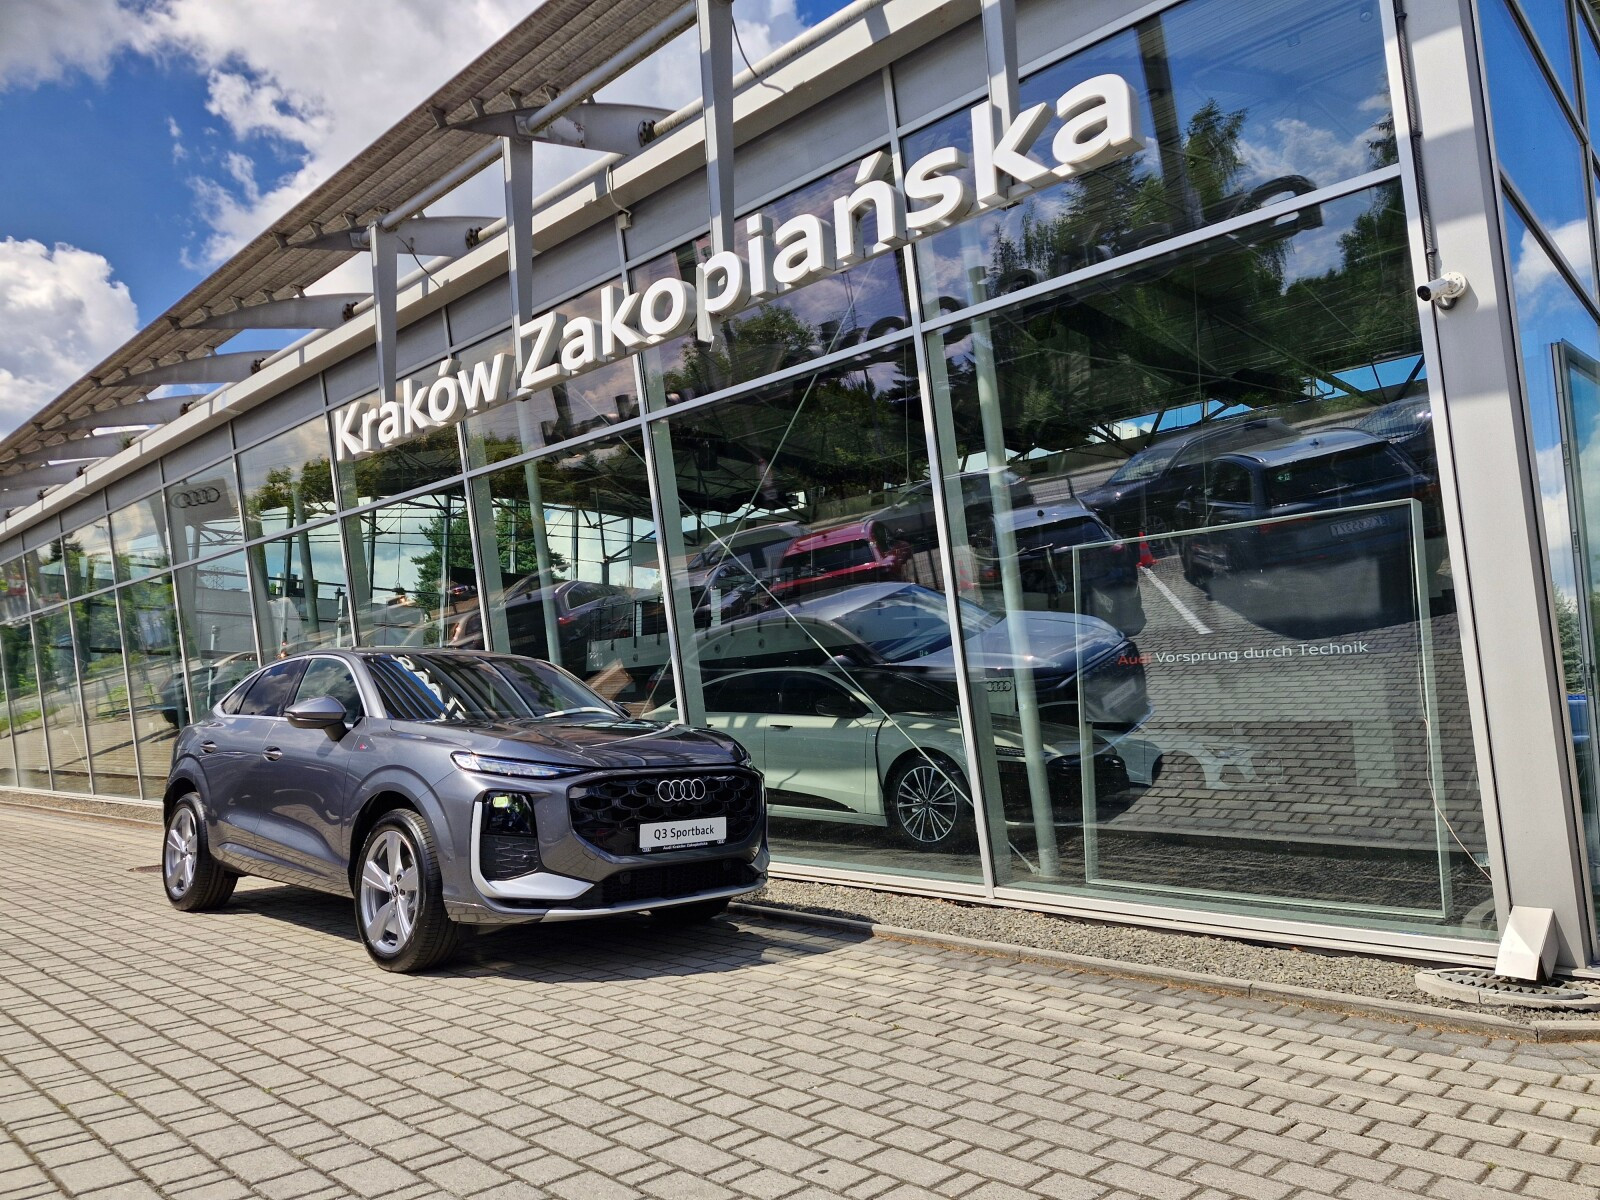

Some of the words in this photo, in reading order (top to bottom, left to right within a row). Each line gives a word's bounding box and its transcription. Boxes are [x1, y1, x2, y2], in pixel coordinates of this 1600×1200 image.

[334, 352, 516, 463] Kraków
[518, 73, 1146, 397] Zakopiańska
[1117, 654, 1152, 666] Audi
[1155, 649, 1239, 665] Vorsprung
[1243, 644, 1293, 659] durch
[1297, 640, 1369, 656] Technik
[653, 828, 668, 840] Q3
[670, 825, 715, 840] Sportback
